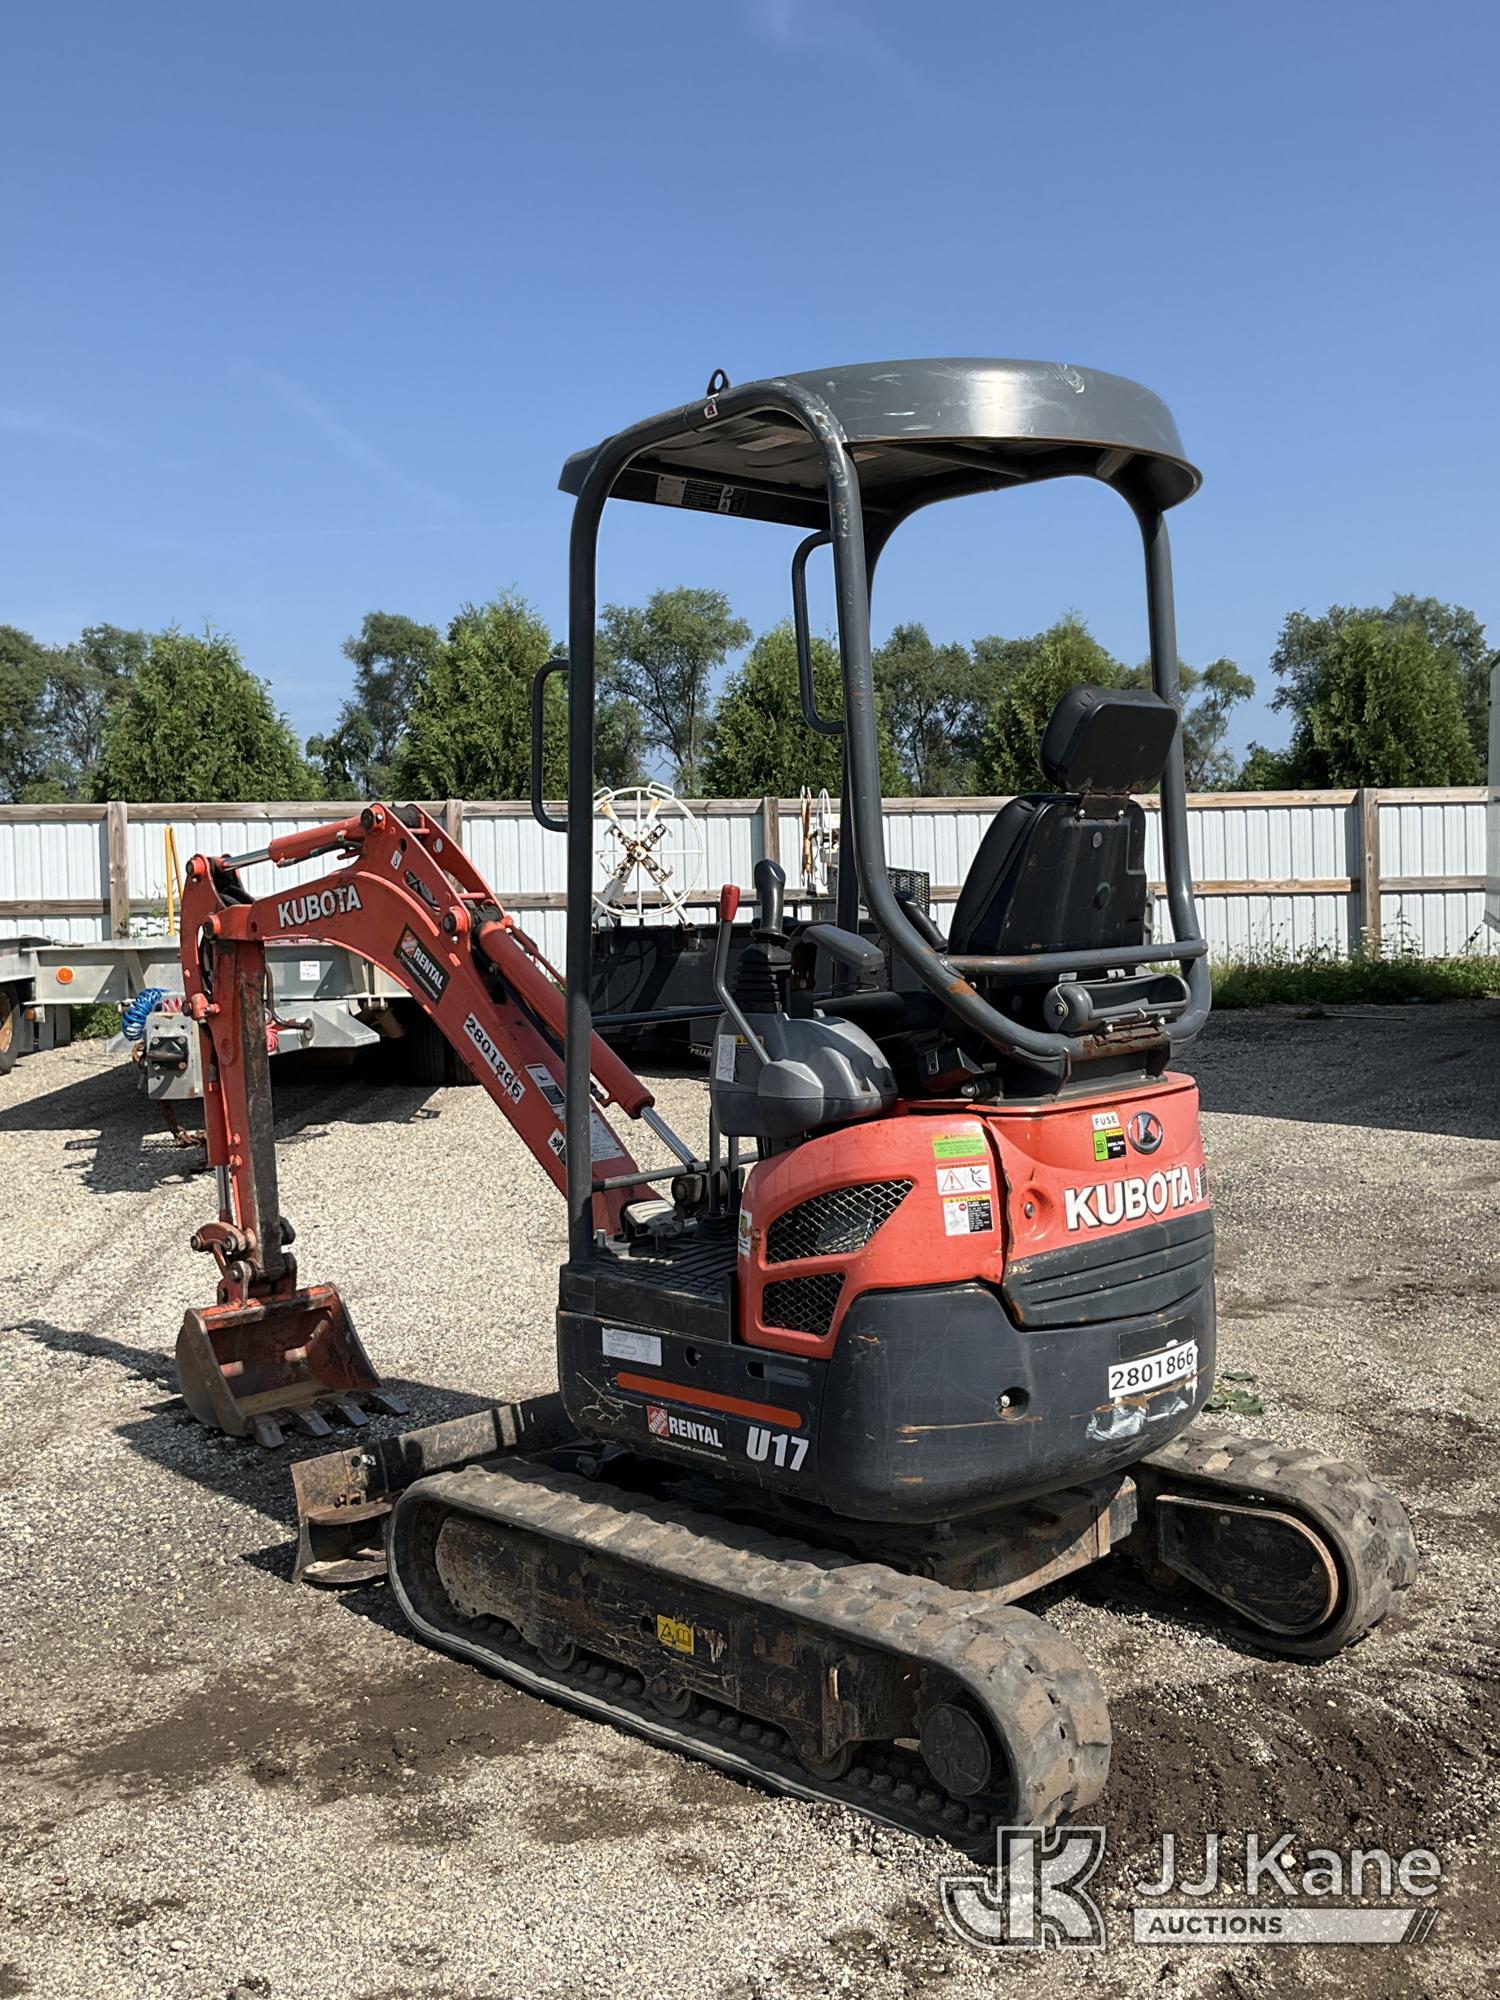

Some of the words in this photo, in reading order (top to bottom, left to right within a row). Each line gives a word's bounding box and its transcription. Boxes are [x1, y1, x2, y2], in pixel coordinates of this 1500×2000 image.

[277, 884, 362, 929] KUBOTA
[413, 946, 444, 990] RENTAL
[466, 1017, 521, 1098] 2801866
[1094, 1115, 1117, 1126] FUSE
[1063, 1165, 1194, 1231] KUBOTA
[1111, 1346, 1194, 1391] 2801866
[668, 1416, 723, 1448] RENTAL
[746, 1425, 810, 1472] U17
